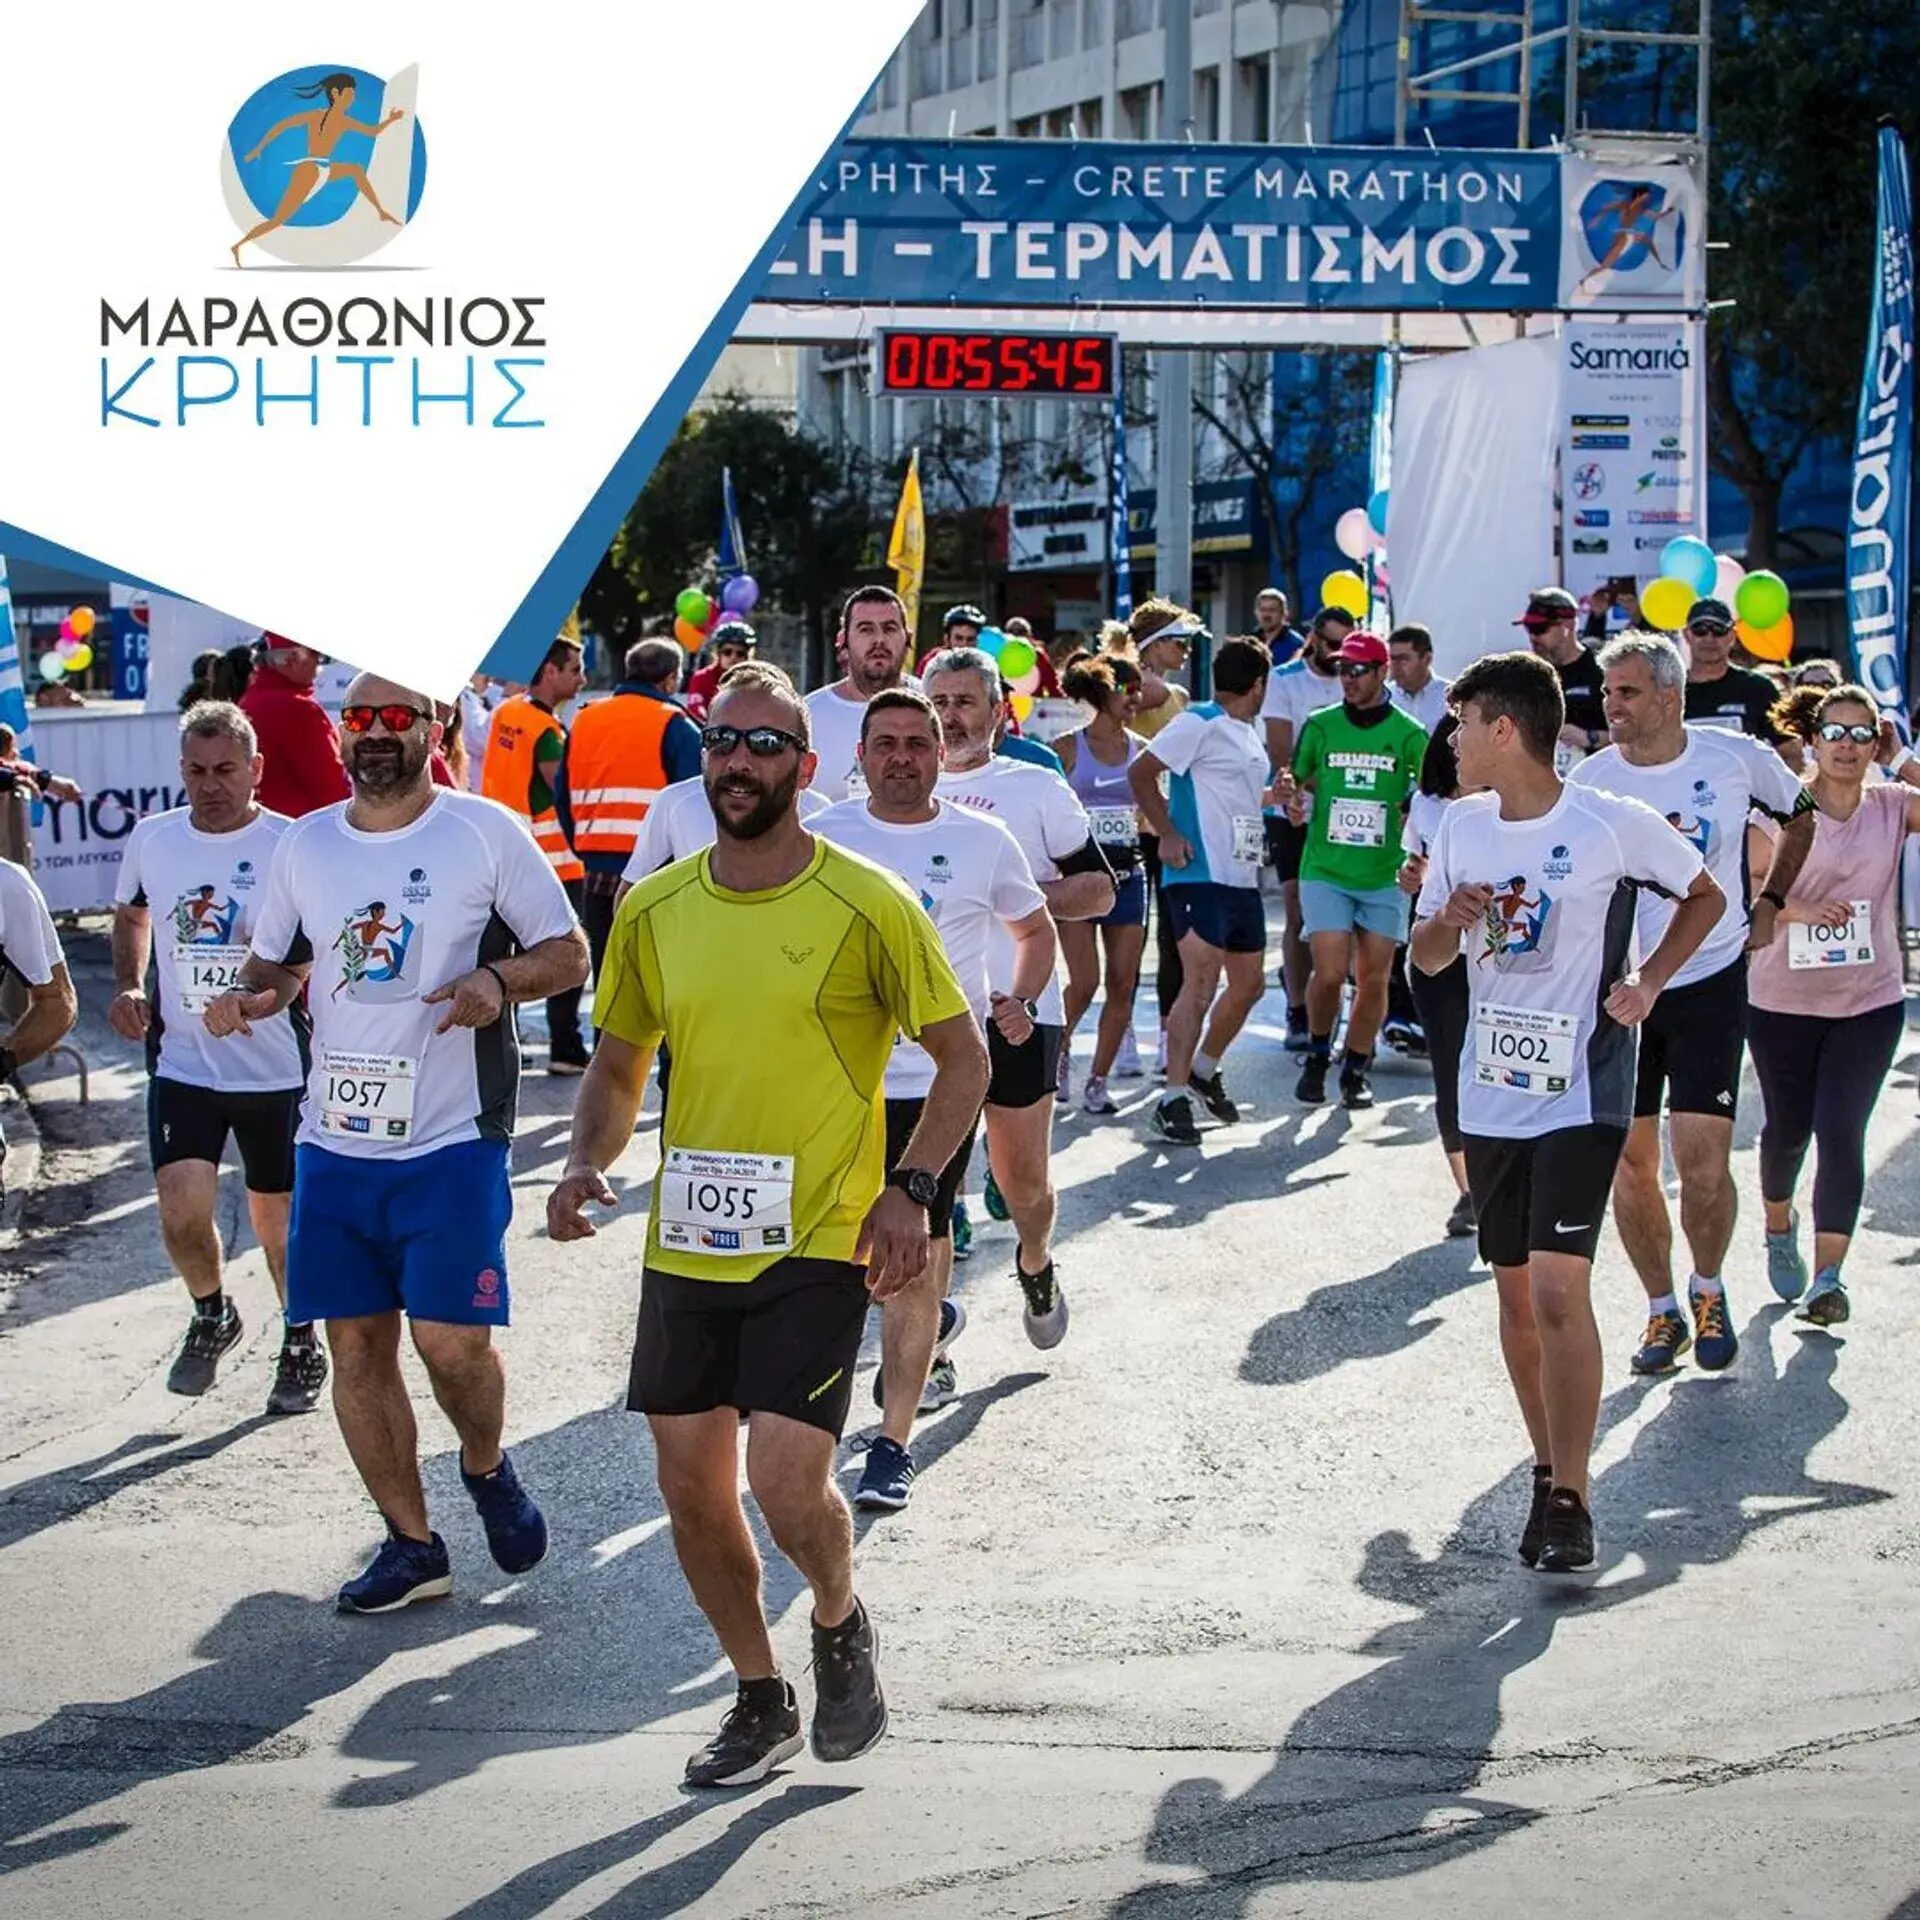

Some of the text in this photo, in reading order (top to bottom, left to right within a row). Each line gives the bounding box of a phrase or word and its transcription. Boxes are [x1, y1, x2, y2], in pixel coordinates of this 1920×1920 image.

[820, 161, 997, 196] ΡΗΤΗΣ
[1074, 165, 1225, 198] CRETE
[1255, 166, 1521, 202] MARATHON
[961, 221, 1530, 285] ΤΕΡΜΑΤΙΣΜΟΣ
[888, 335, 1102, 390] 00:55:45
[1339, 813, 1376, 829] 1022
[78, 850, 123, 866] ΛΕΥΚΩ
[1807, 921, 1856, 942] 1001
[1491, 1031, 1551, 1063] 1002
[329, 1077, 387, 1107] 1057
[687, 1181, 758, 1220] 1055
[714, 1231, 738, 1247] FREE
